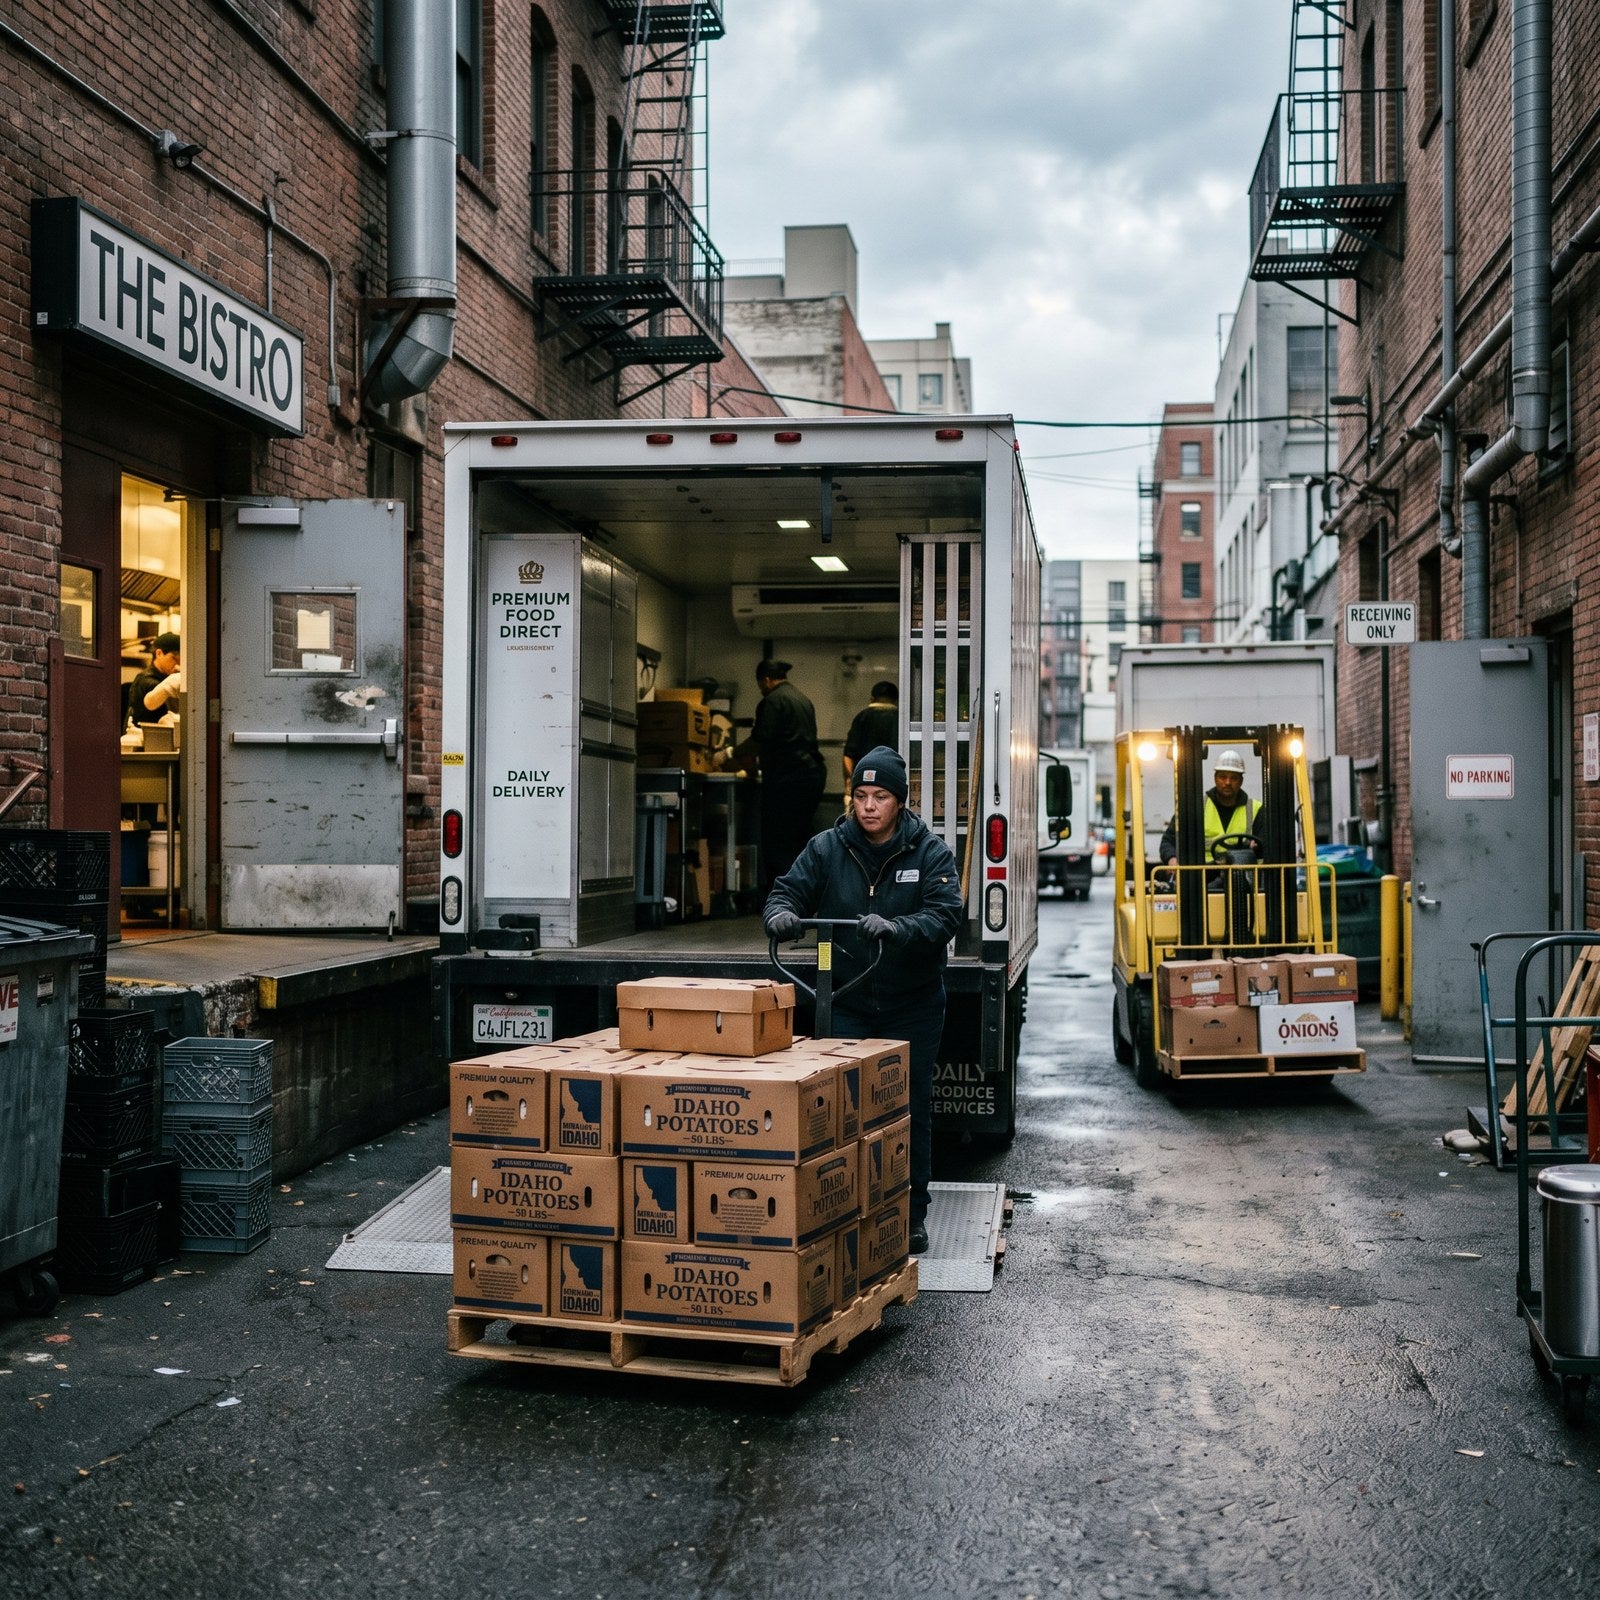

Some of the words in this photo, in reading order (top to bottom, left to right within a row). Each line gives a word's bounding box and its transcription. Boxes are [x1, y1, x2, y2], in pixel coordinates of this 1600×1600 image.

[91, 229, 166, 351] THE
[178, 280, 293, 412] BISTRO
[492, 592, 570, 606] PREMIUM
[506, 609, 555, 622] FOOD
[1351, 607, 1411, 622] RECEIVING
[500, 625, 562, 638] DIRECT
[1367, 625, 1396, 639] ONLY
[507, 770, 551, 782] DAILY
[1451, 770, 1464, 783] NO
[1467, 770, 1510, 783] PARKING
[493, 786, 566, 798] DELIVERY
[478, 1019, 547, 1039] C4JFL231
[1278, 1022, 1339, 1039] ONIONS
[459, 1073, 497, 1083] PREMIUM
[499, 1075, 535, 1085] QUALITY
[932, 1085, 995, 1099] RODUCE
[673, 1098, 740, 1116] IDAHO
[656, 1114, 759, 1135] POTATOES
[563, 1131, 599, 1145] IDAHO
[500, 1172, 563, 1192] IDAHO
[704, 1170, 744, 1179] PREMIUM
[746, 1172, 785, 1182] QUALITY
[483, 1187, 580, 1210] POTATOES
[637, 1218, 674, 1234] IDAHO
[461, 1237, 499, 1247] PREMIUM
[500, 1239, 538, 1250] QUALITY
[673, 1267, 740, 1287] IDAHO
[656, 1283, 758, 1307] POTATOES
[563, 1296, 599, 1312] IDAHO
